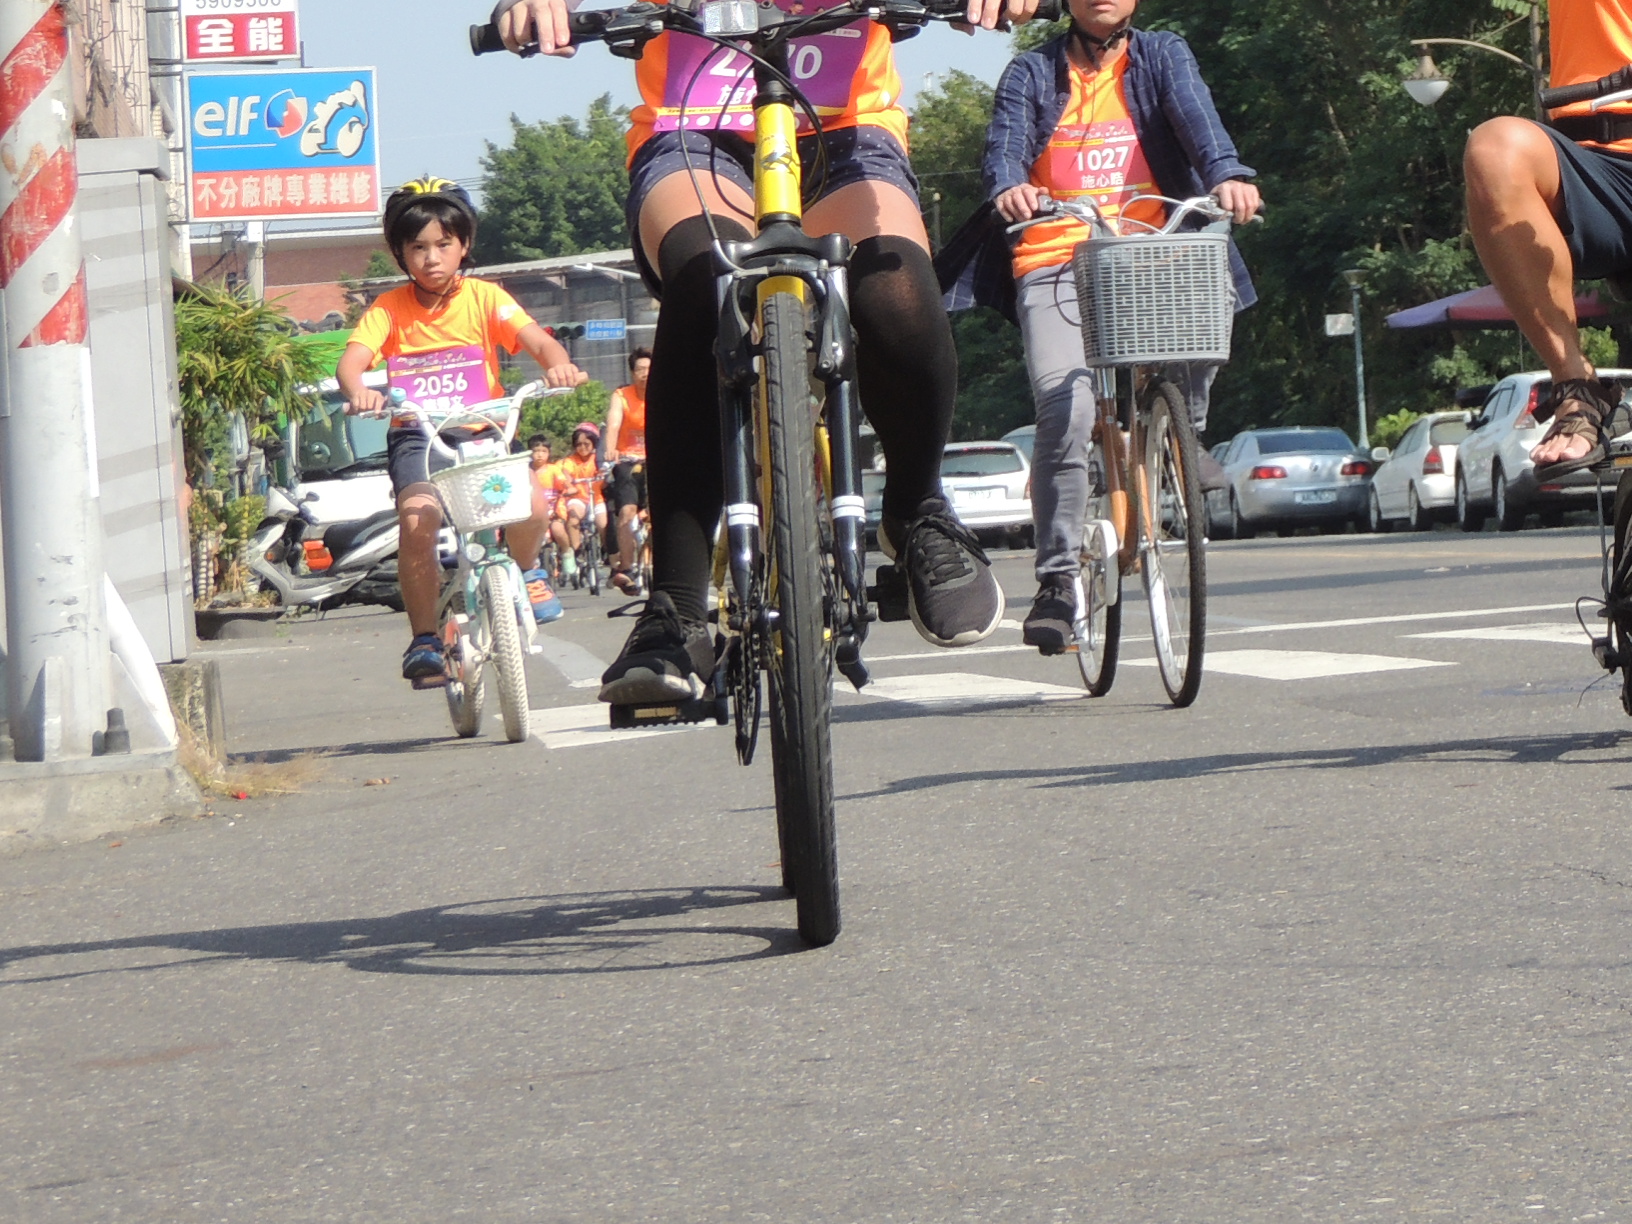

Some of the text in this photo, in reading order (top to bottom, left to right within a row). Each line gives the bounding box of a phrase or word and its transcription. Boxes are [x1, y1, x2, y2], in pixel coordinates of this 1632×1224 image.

[197, 16, 284, 54] 全能
[709, 40, 822, 79] 20
[194, 95, 261, 137] elf
[1076, 146, 1129, 171] 1027
[196, 172, 371, 211] 不分廠牌專業維修
[413, 372, 468, 398] 2056
